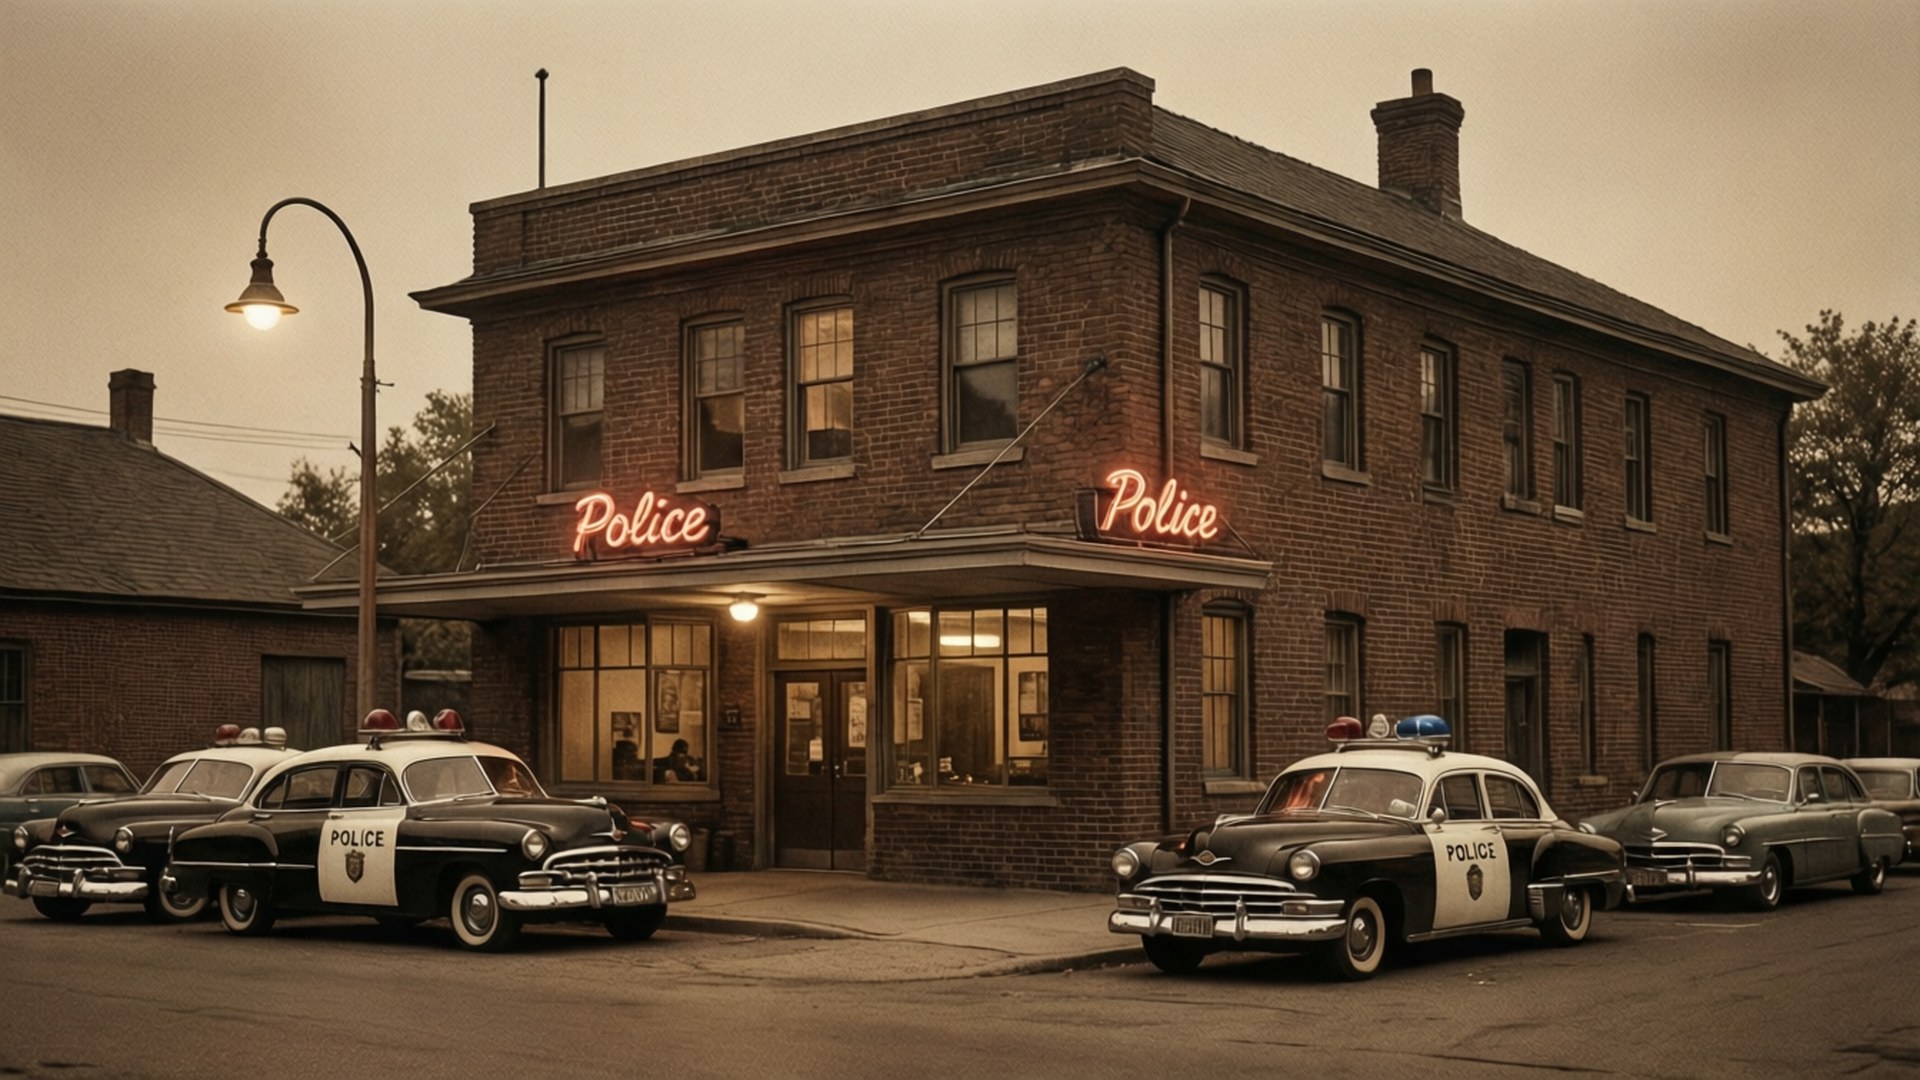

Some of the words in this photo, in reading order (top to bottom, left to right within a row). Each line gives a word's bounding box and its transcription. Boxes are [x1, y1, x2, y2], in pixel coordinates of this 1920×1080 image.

[573, 491, 710, 552] Police
[1101, 468, 1218, 539] Police
[330, 829, 385, 847] POLICE
[1445, 842, 1497, 862] POLICE
